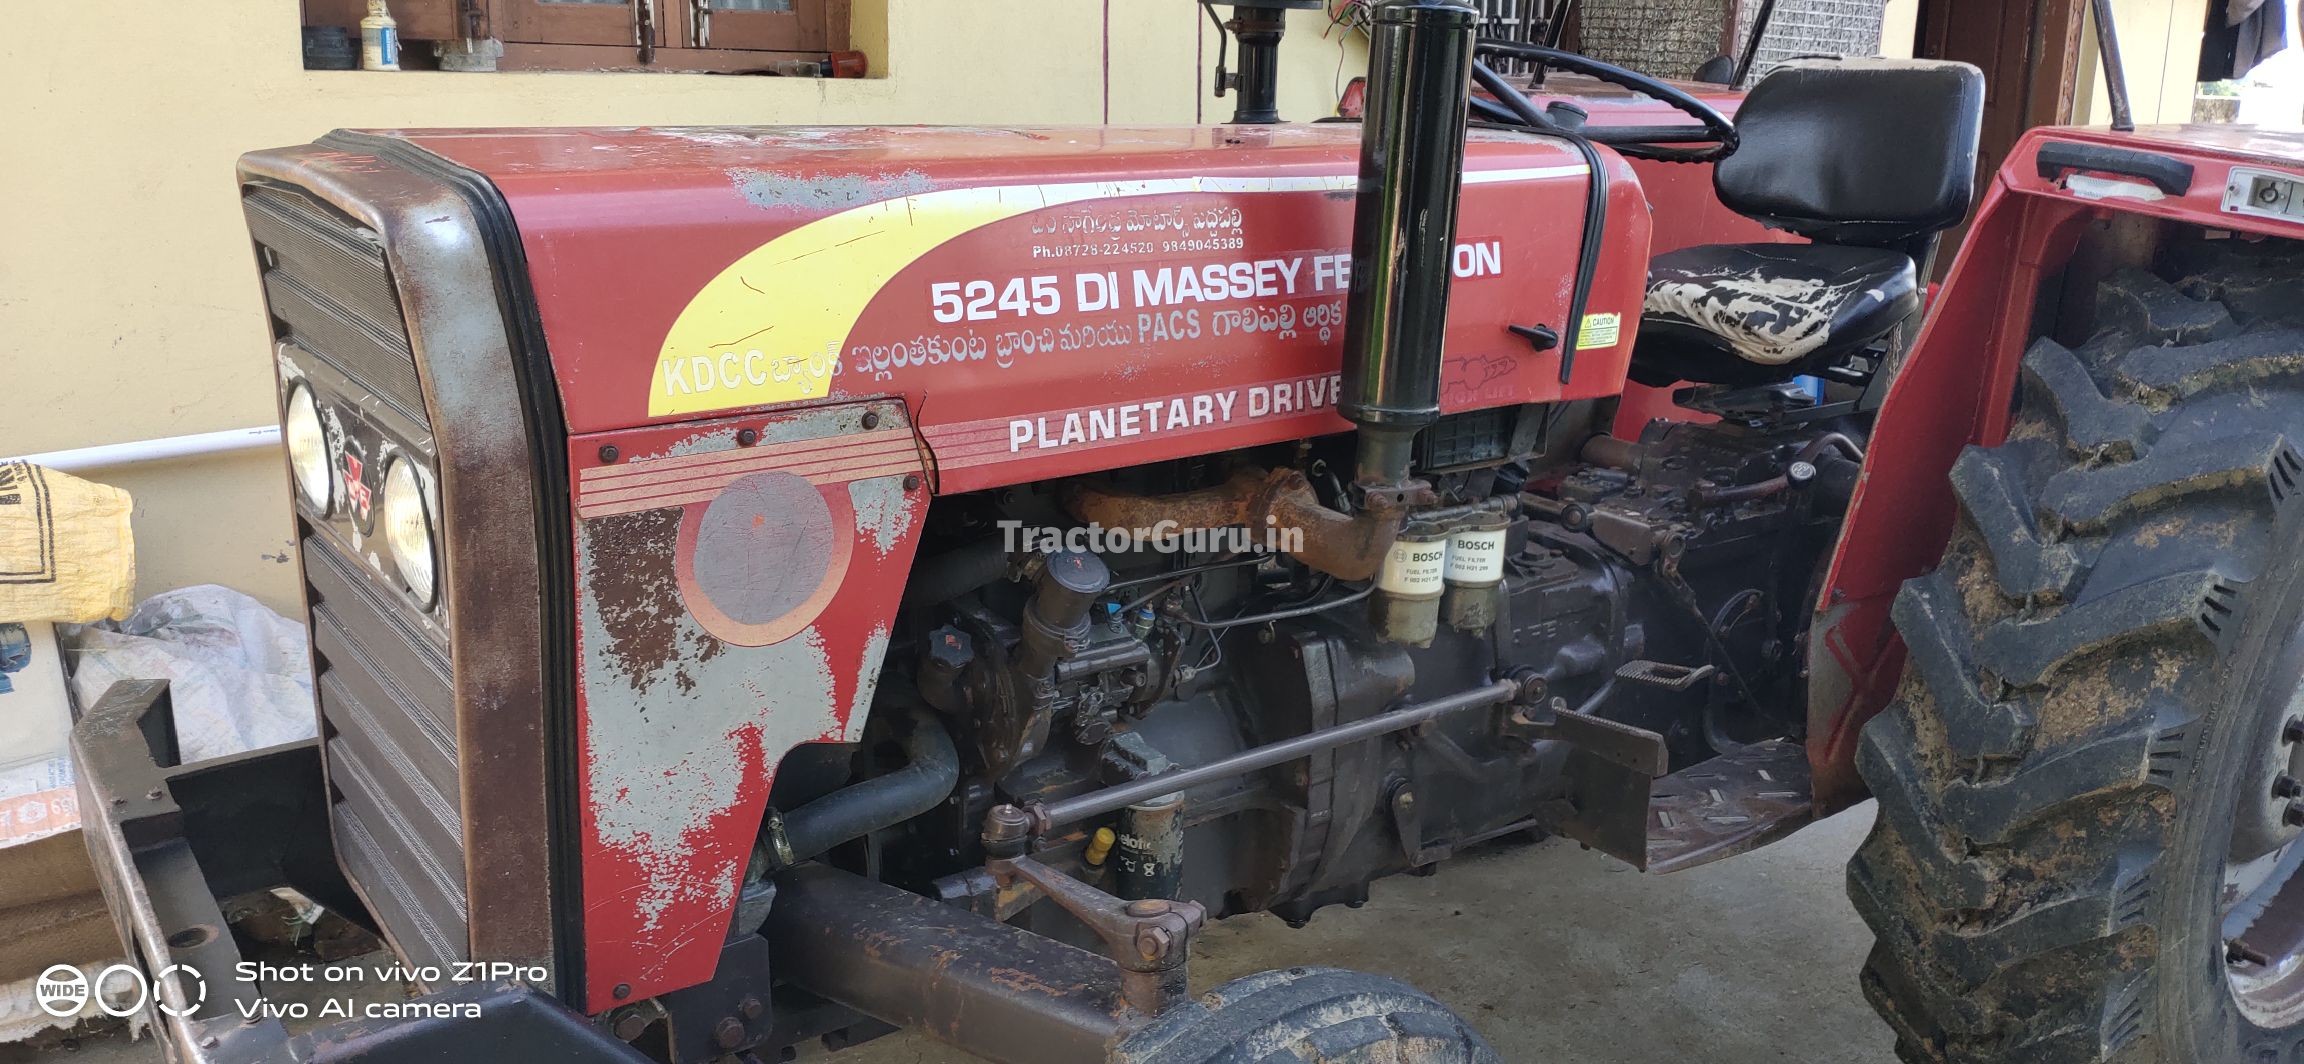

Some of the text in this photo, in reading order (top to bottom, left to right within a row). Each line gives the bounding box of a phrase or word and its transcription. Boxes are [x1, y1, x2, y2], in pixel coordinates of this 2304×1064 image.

[1162, 237, 1244, 253] 9849045389
[931, 276, 1061, 323] 5245
[1076, 271, 1119, 312] DI
[1133, 257, 1303, 309] MASSEY
[1592, 317, 1615, 327] CAUTION
[662, 349, 768, 397] KDCC
[1138, 308, 1201, 344] PACS
[1009, 375, 1341, 453] PLANETARY DRIVE
[1457, 540, 1495, 551] BOSCH
[1412, 551, 1443, 562] BOSCH
